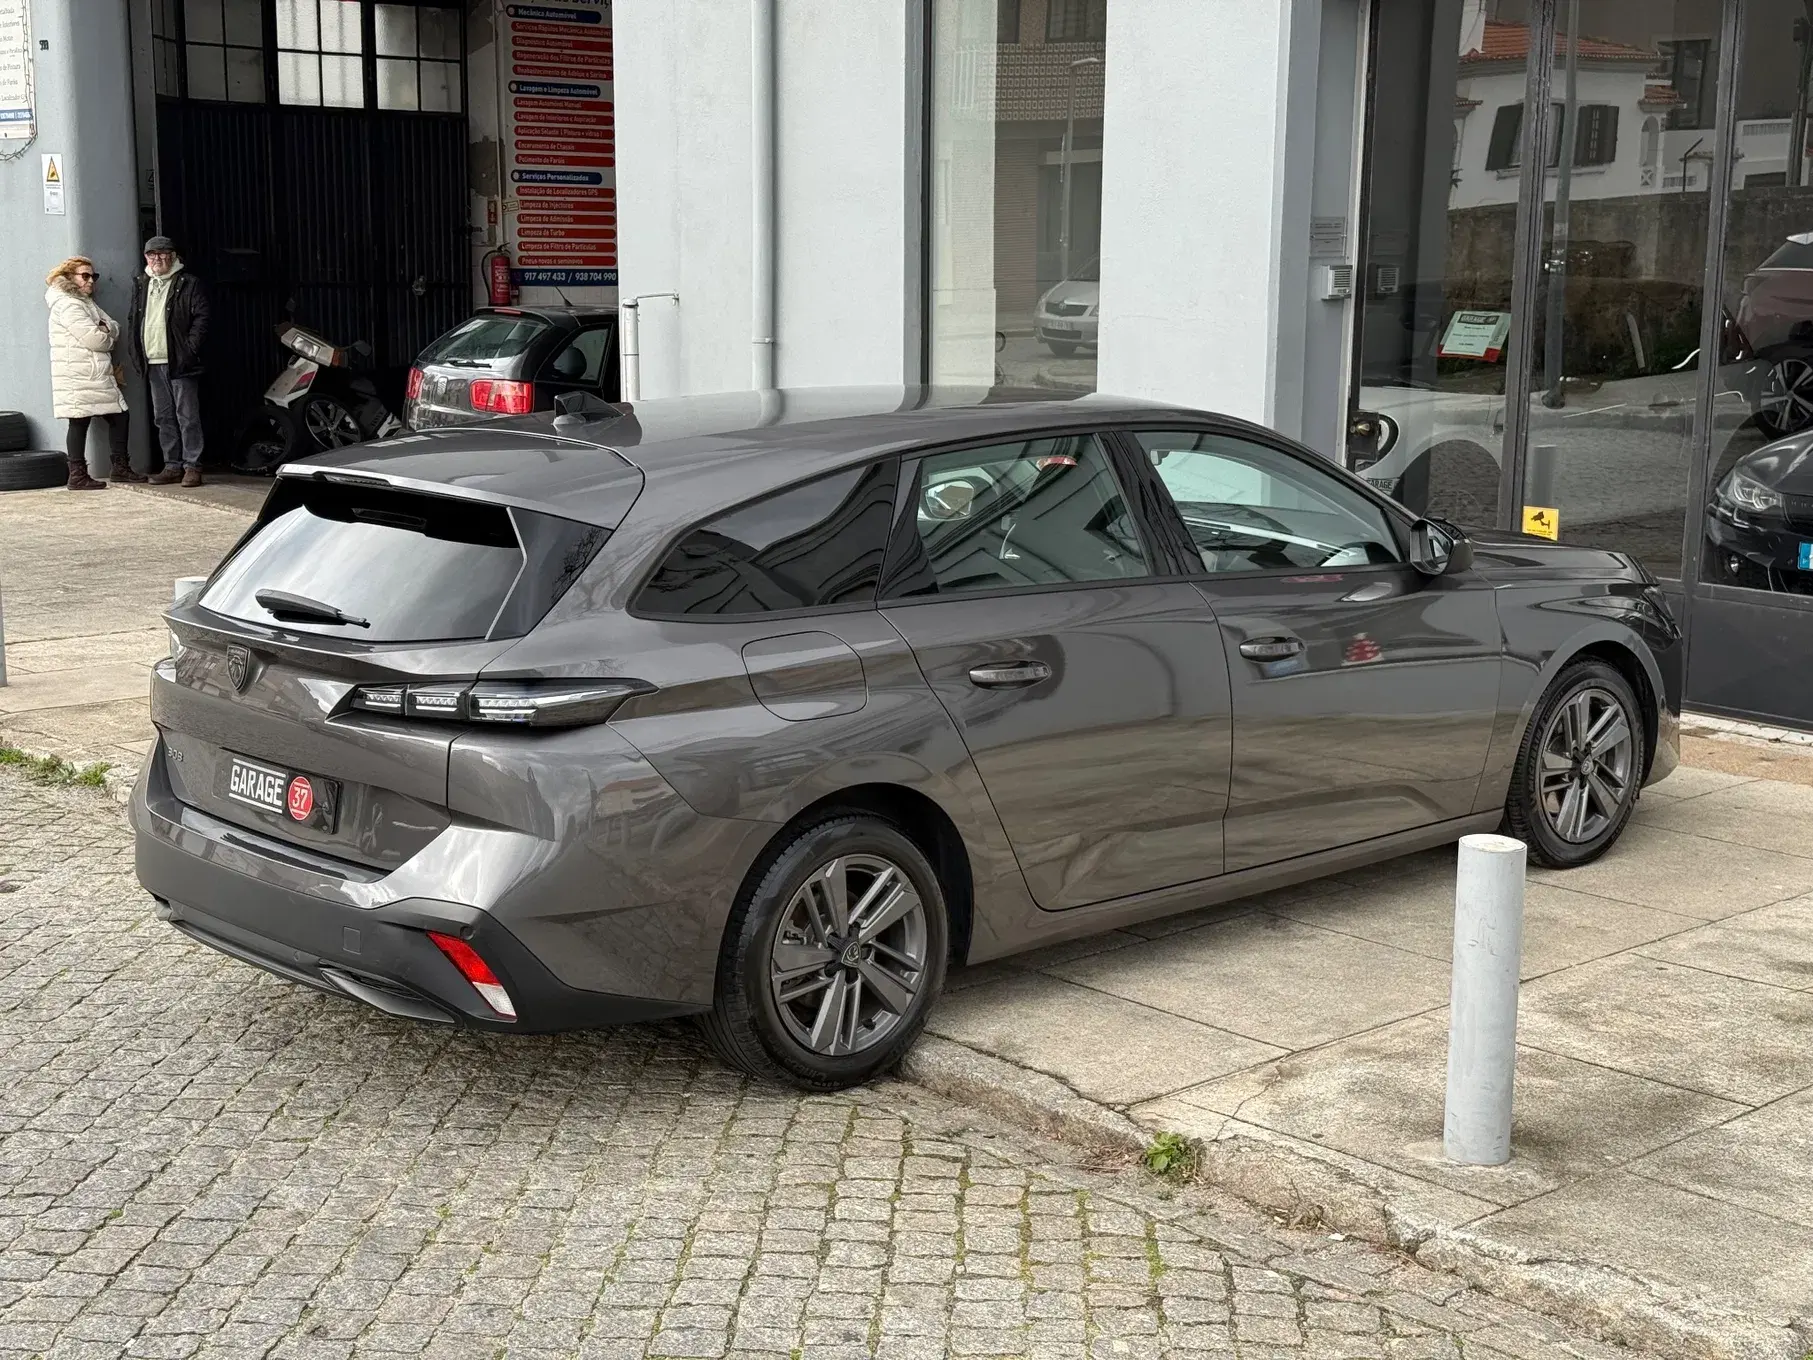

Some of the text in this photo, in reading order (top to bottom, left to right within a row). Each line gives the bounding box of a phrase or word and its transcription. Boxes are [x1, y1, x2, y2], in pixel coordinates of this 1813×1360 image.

[520, 84, 544, 94] Lavagem
[522, 172, 589, 182] Serviços Personalizados
[520, 201, 542, 210] Limpeza
[520, 215, 542, 224] Limpeza
[521, 229, 542, 238] Limpeza
[549, 229, 565, 237] Turbo
[521, 242, 543, 251] Limpeza
[524, 272, 537, 281] 917
[537, 272, 552, 281] 497
[552, 272, 566, 281] 433
[575, 272, 589, 281] 938
[589, 272, 602, 281] 704
[603, 272, 617, 281] 990
[168, 747, 183, 762] 308
[230, 765, 307, 810] GARAGE 37
